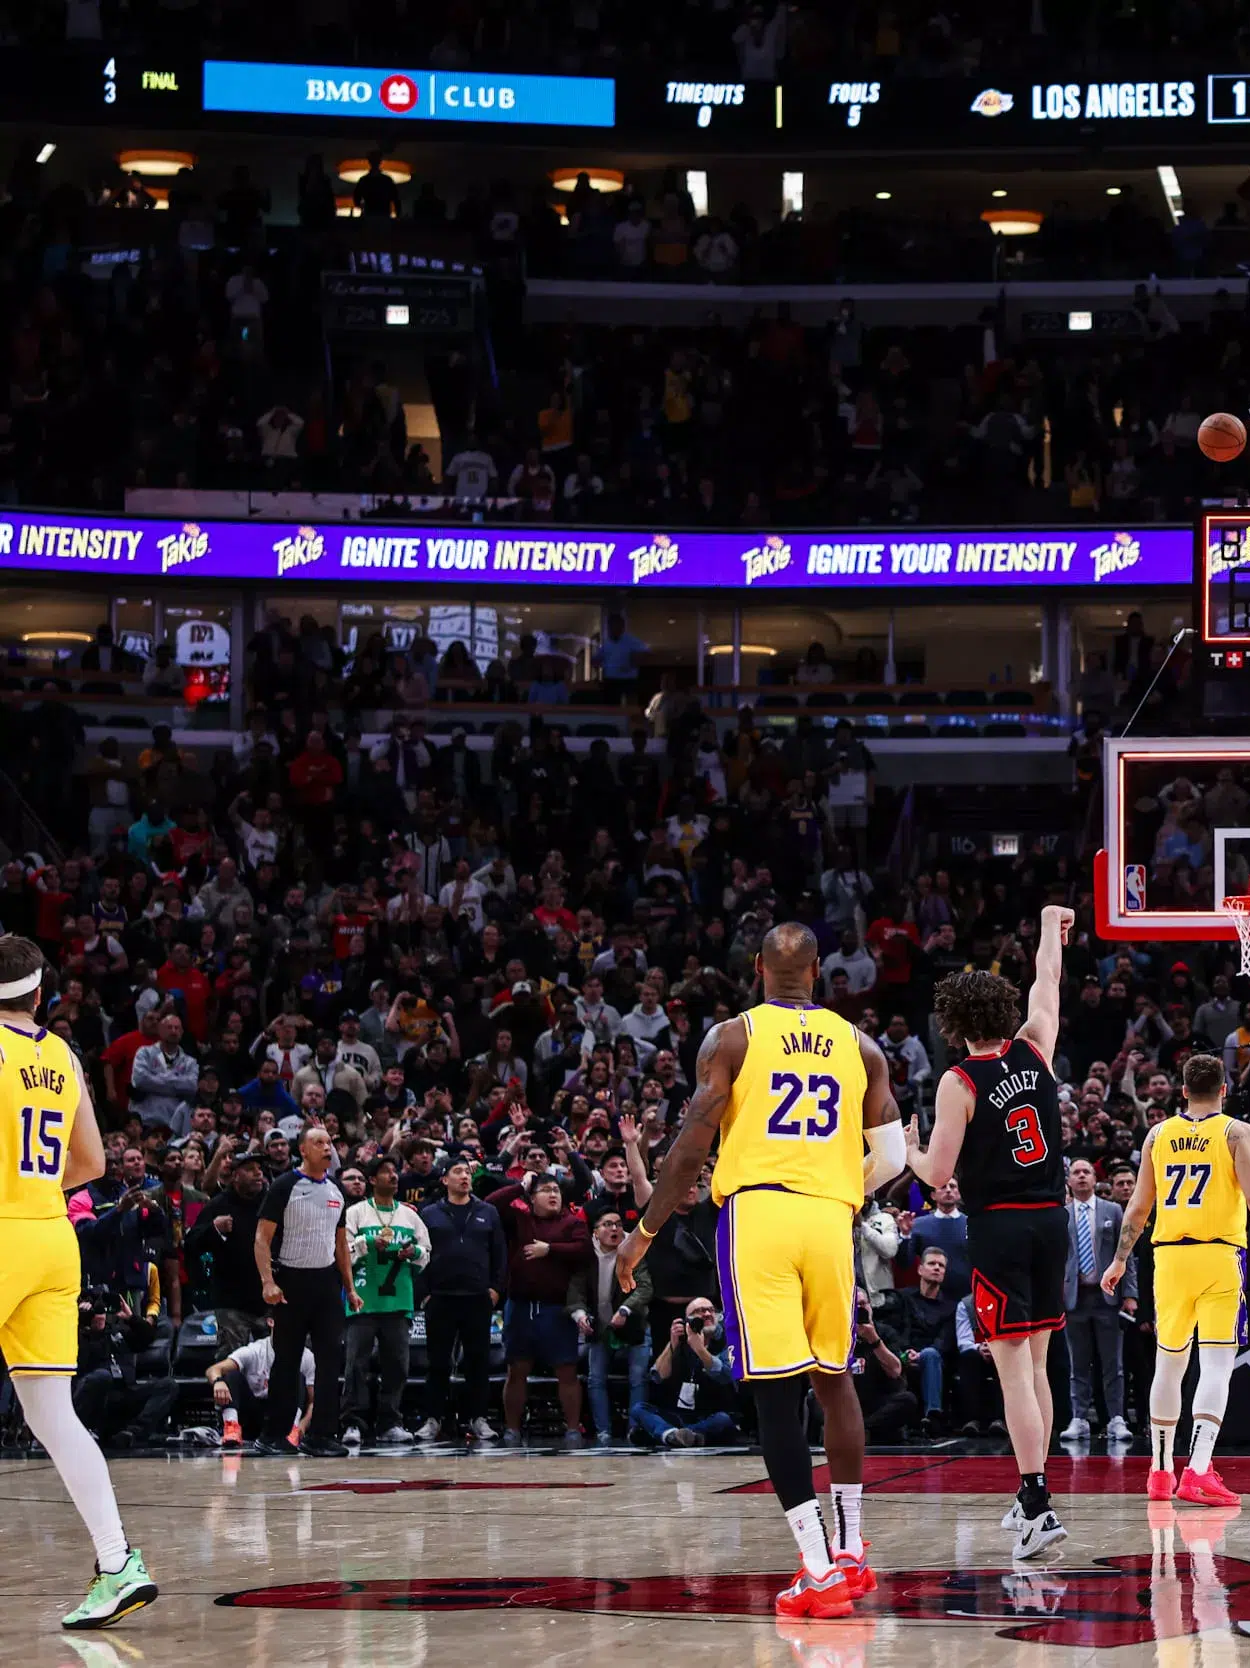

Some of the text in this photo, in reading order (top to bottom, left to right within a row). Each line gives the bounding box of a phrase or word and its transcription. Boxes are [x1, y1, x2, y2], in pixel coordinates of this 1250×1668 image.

[104, 58, 116, 79] 4
[142, 71, 179, 91] FINAL
[104, 81, 116, 103] 3
[306, 79, 516, 109] BMO CLUB
[666, 81, 745, 105] TIMEOUTS
[829, 82, 881, 104] FOULS
[1032, 85, 1081, 119] LOS
[1085, 82, 1195, 118] ANGELES
[697, 105, 712, 127] 0
[847, 104, 862, 127] 5
[19, 524, 143, 561] INTENSITY
[157, 530, 210, 573] Takis
[272, 531, 326, 576] Takis
[340, 535, 615, 572] IGNITE YOUR INTENSITY
[807, 542, 1077, 574] IGNITE YOUR INTENSITY
[628, 542, 681, 584] Takis
[741, 542, 794, 584] Takis
[1090, 541, 1142, 582] Takis
[781, 1031, 833, 1058] JAMES
[766, 1071, 842, 1140] 23
[988, 1070, 1039, 1110] GIDDEY
[19, 1106, 63, 1178] 15
[1005, 1103, 1049, 1167] 3
[1170, 1133, 1211, 1153] DONČIĆ
[1164, 1164, 1212, 1209] 77
